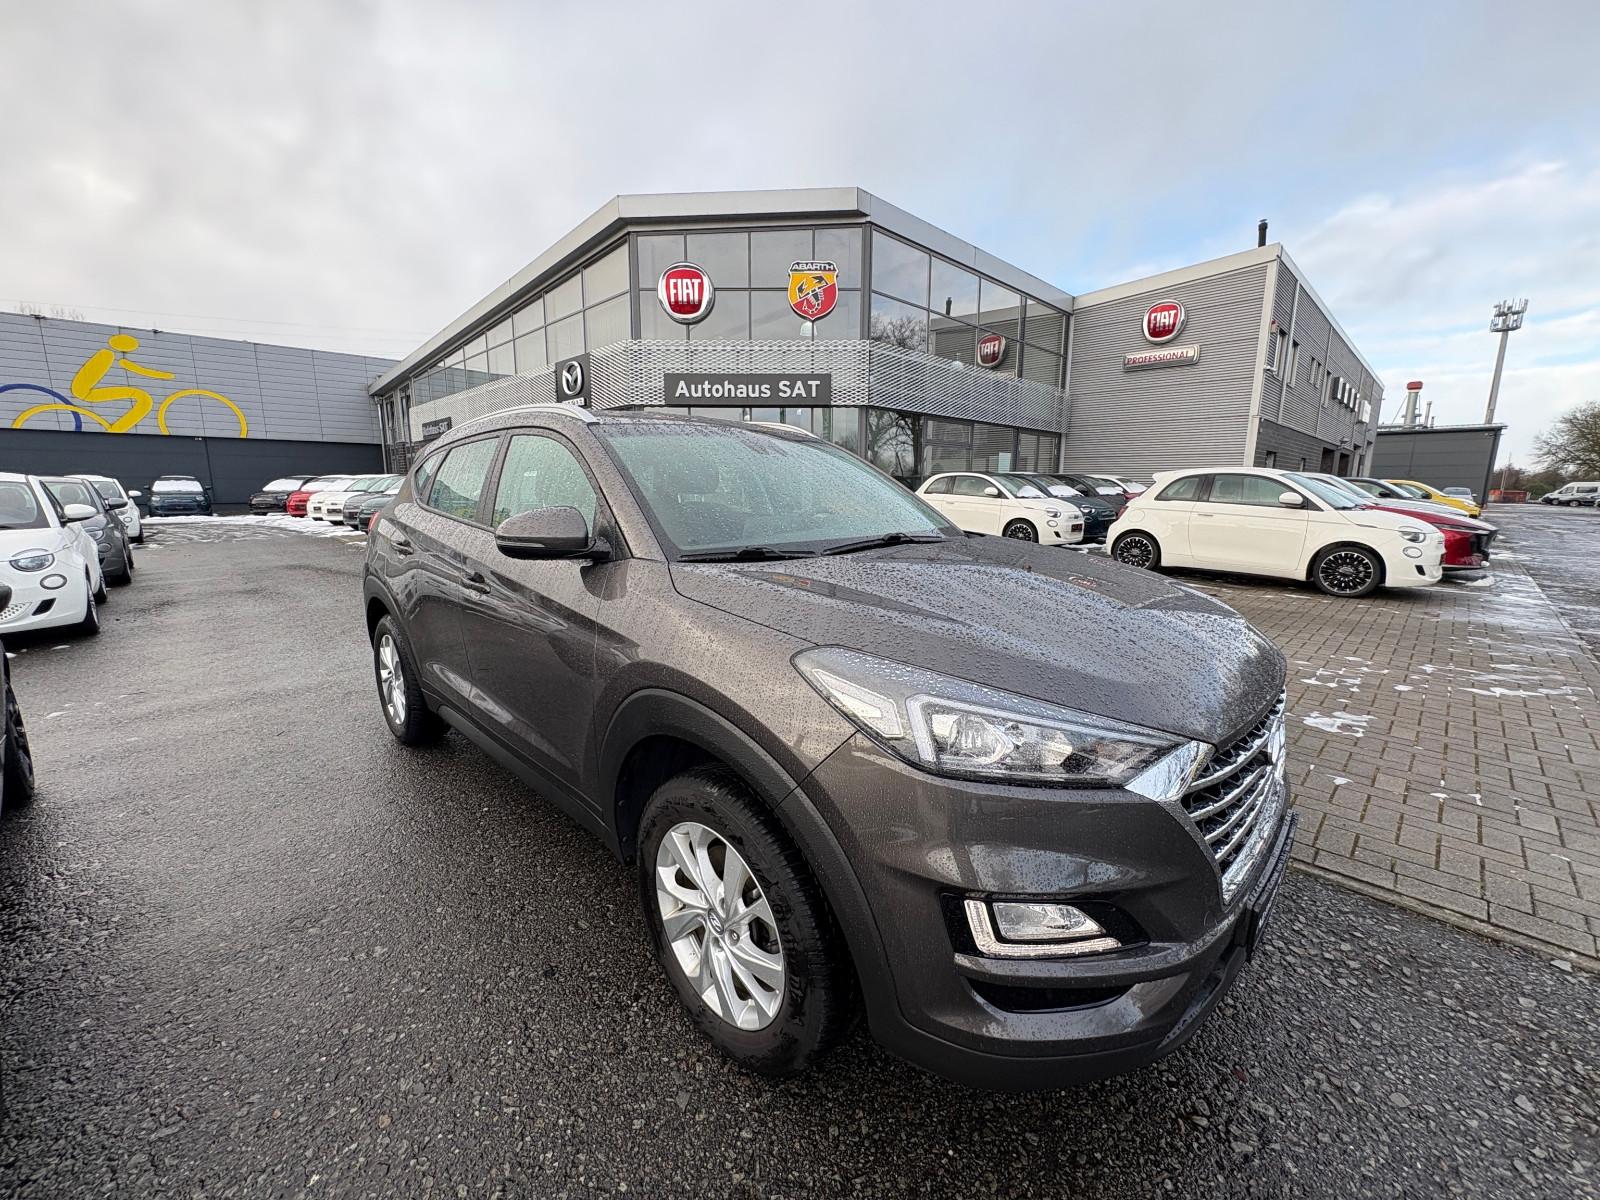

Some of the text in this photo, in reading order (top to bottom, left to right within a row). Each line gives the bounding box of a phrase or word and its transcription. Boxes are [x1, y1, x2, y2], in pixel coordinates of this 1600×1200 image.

[792, 263, 834, 271] ABARTH
[669, 278, 701, 304] FIAT
[1150, 309, 1177, 332] FIAT
[1126, 350, 1190, 365] PROFESSIONAL
[675, 379, 821, 398] Autohaus SAT
